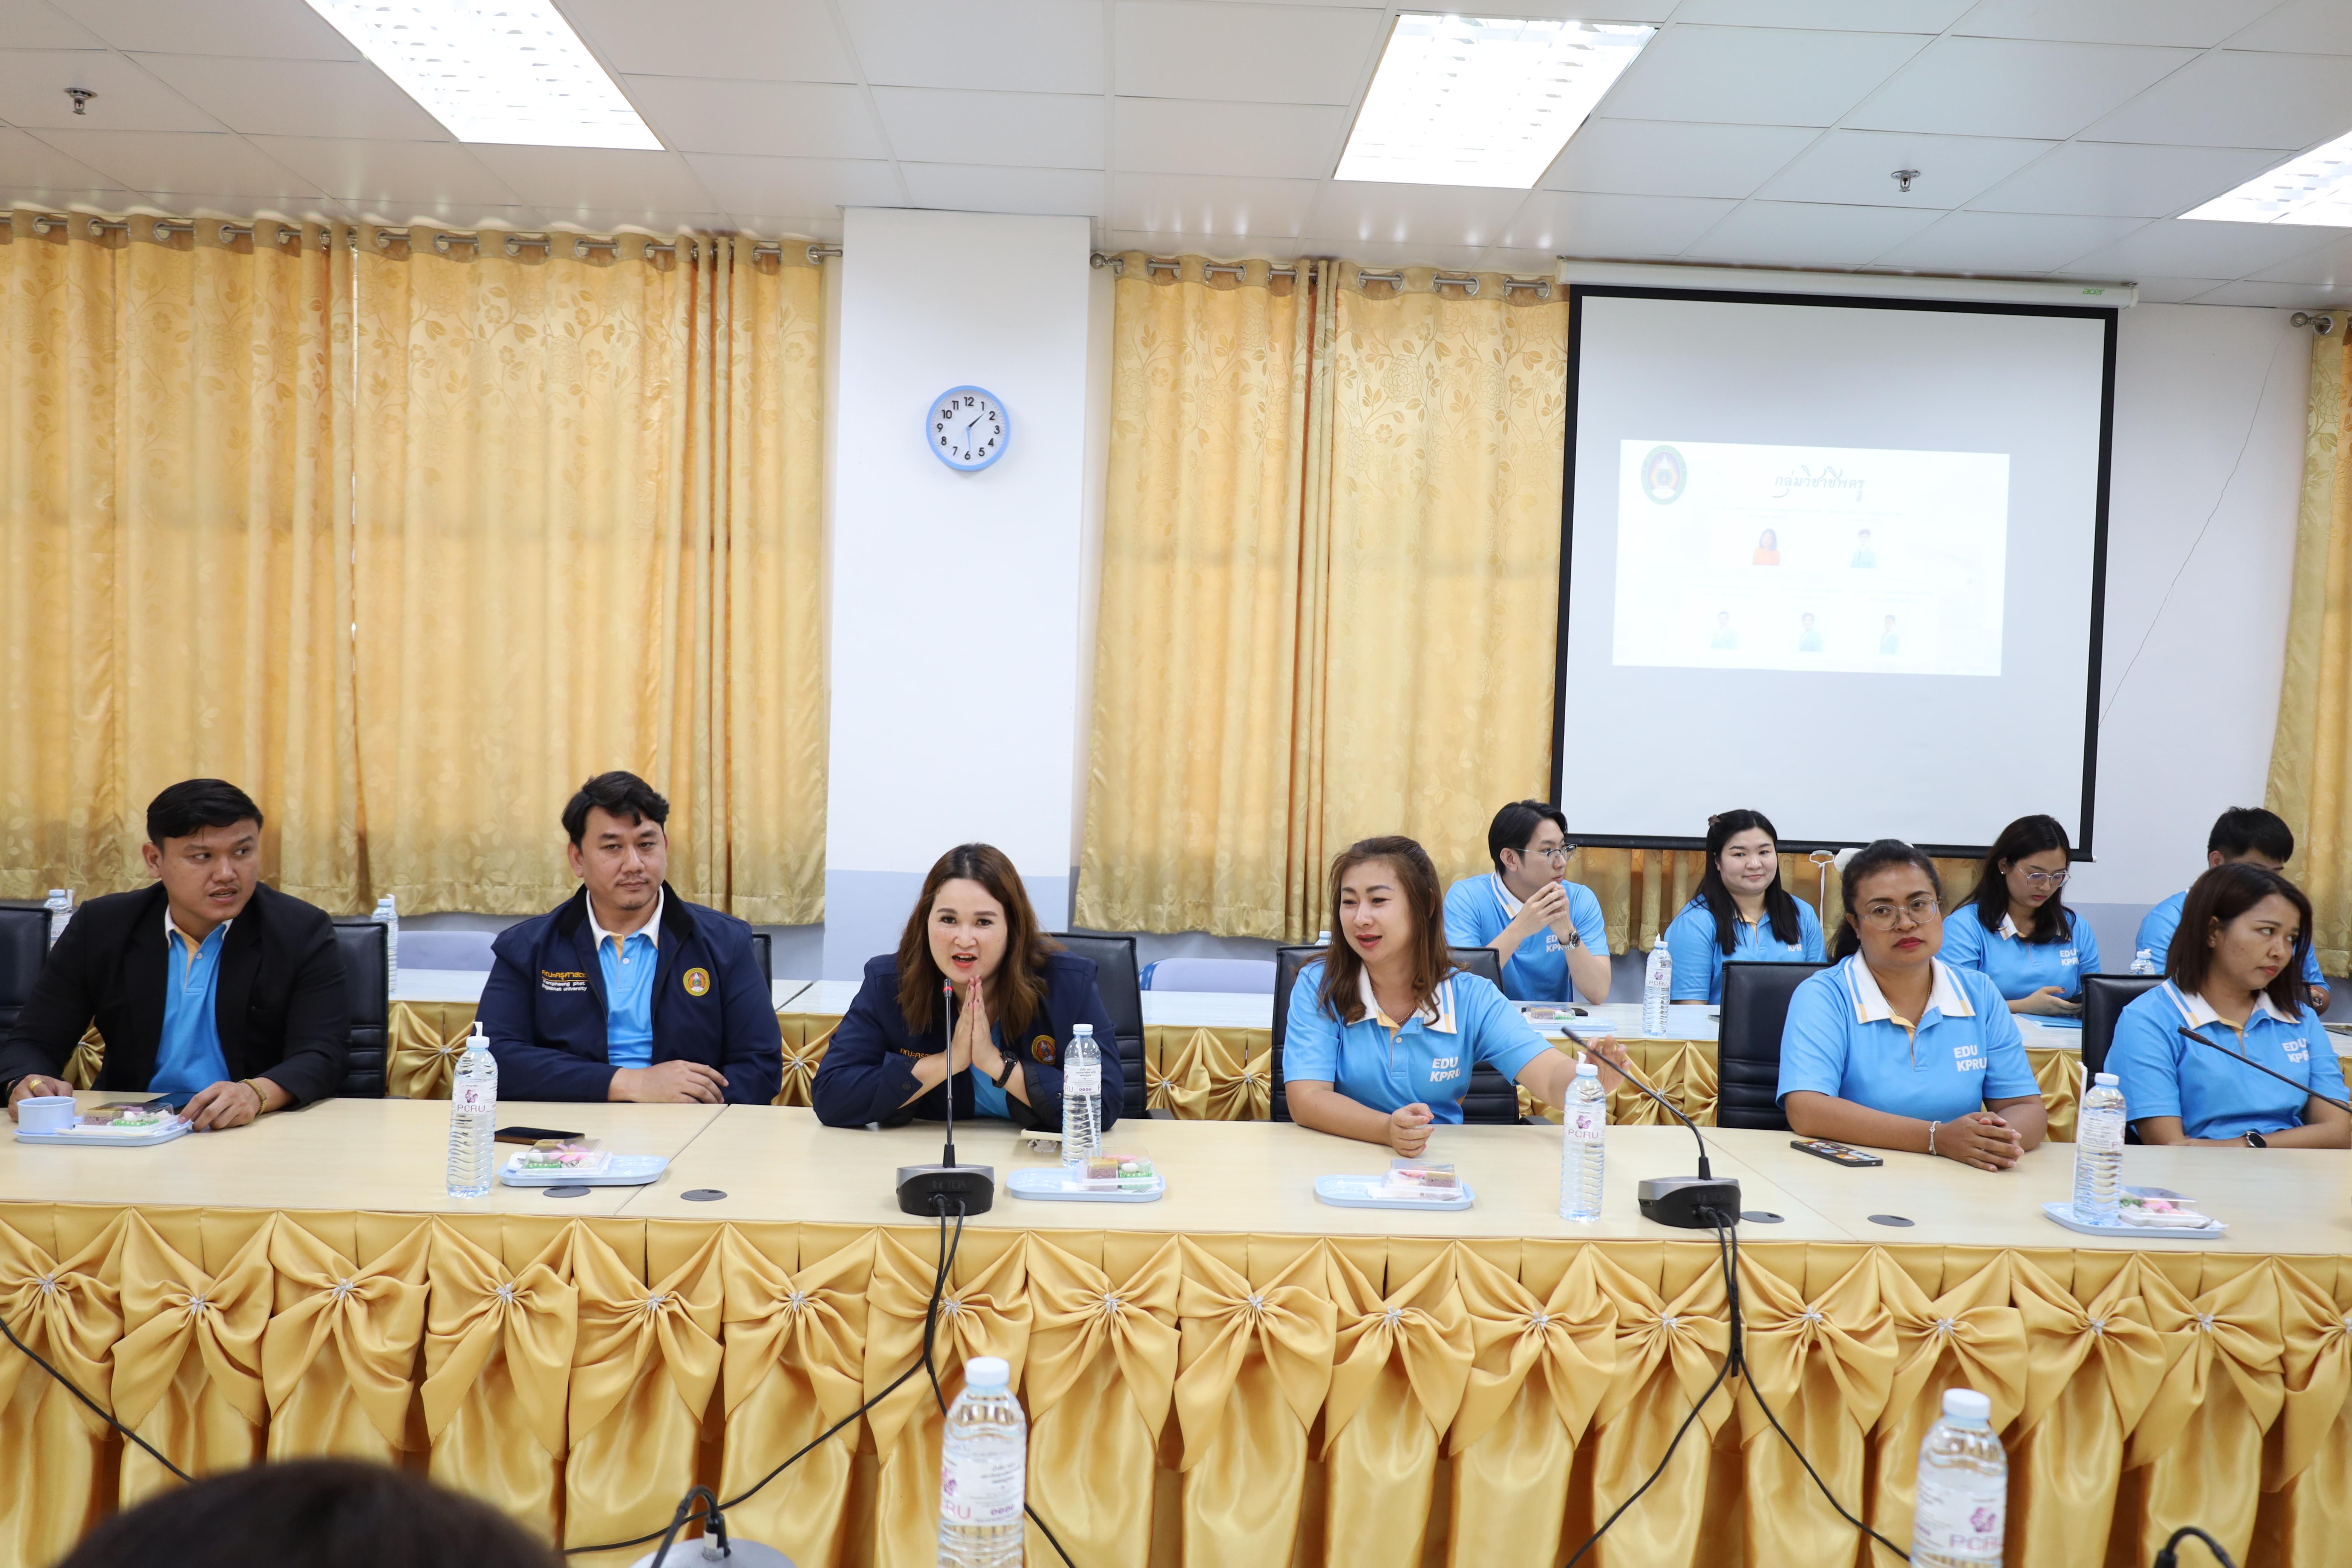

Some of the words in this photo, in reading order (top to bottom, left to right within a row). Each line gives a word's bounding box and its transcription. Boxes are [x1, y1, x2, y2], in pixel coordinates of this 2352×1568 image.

[952, 400, 959, 410] 11
[964, 397, 974, 406] 12
[981, 401, 985, 411] 1
[942, 410, 952, 419] 10
[989, 411, 995, 420] 2
[937, 423, 943, 432] 9
[994, 425, 1000, 434] 3
[941, 436, 947, 446] 8
[988, 438, 994, 447] 4
[953, 446, 958, 456] 7
[964, 450, 971, 460] 6
[978, 447, 985, 456] 5
[1771, 465, 1865, 502] กลุ่มวิชาชีพครู
[1546, 934, 1557, 943] ED
[2060, 948, 2076, 957] EDU
[2061, 957, 2079, 966] KPR
[2282, 1038, 2307, 1052] EDU
[1954, 1045, 1978, 1058] EDU
[2286, 1050, 2309, 1063] KPR
[1432, 1057, 1459, 1069] EDU
[1956, 1057, 1987, 1072] KPRU
[1430, 1067, 1461, 1082] KPRU
[1568, 1129, 1599, 1139] PCRU
[946, 1180, 966, 1189] TOA
[1949, 1534, 1999, 1550] PCR
